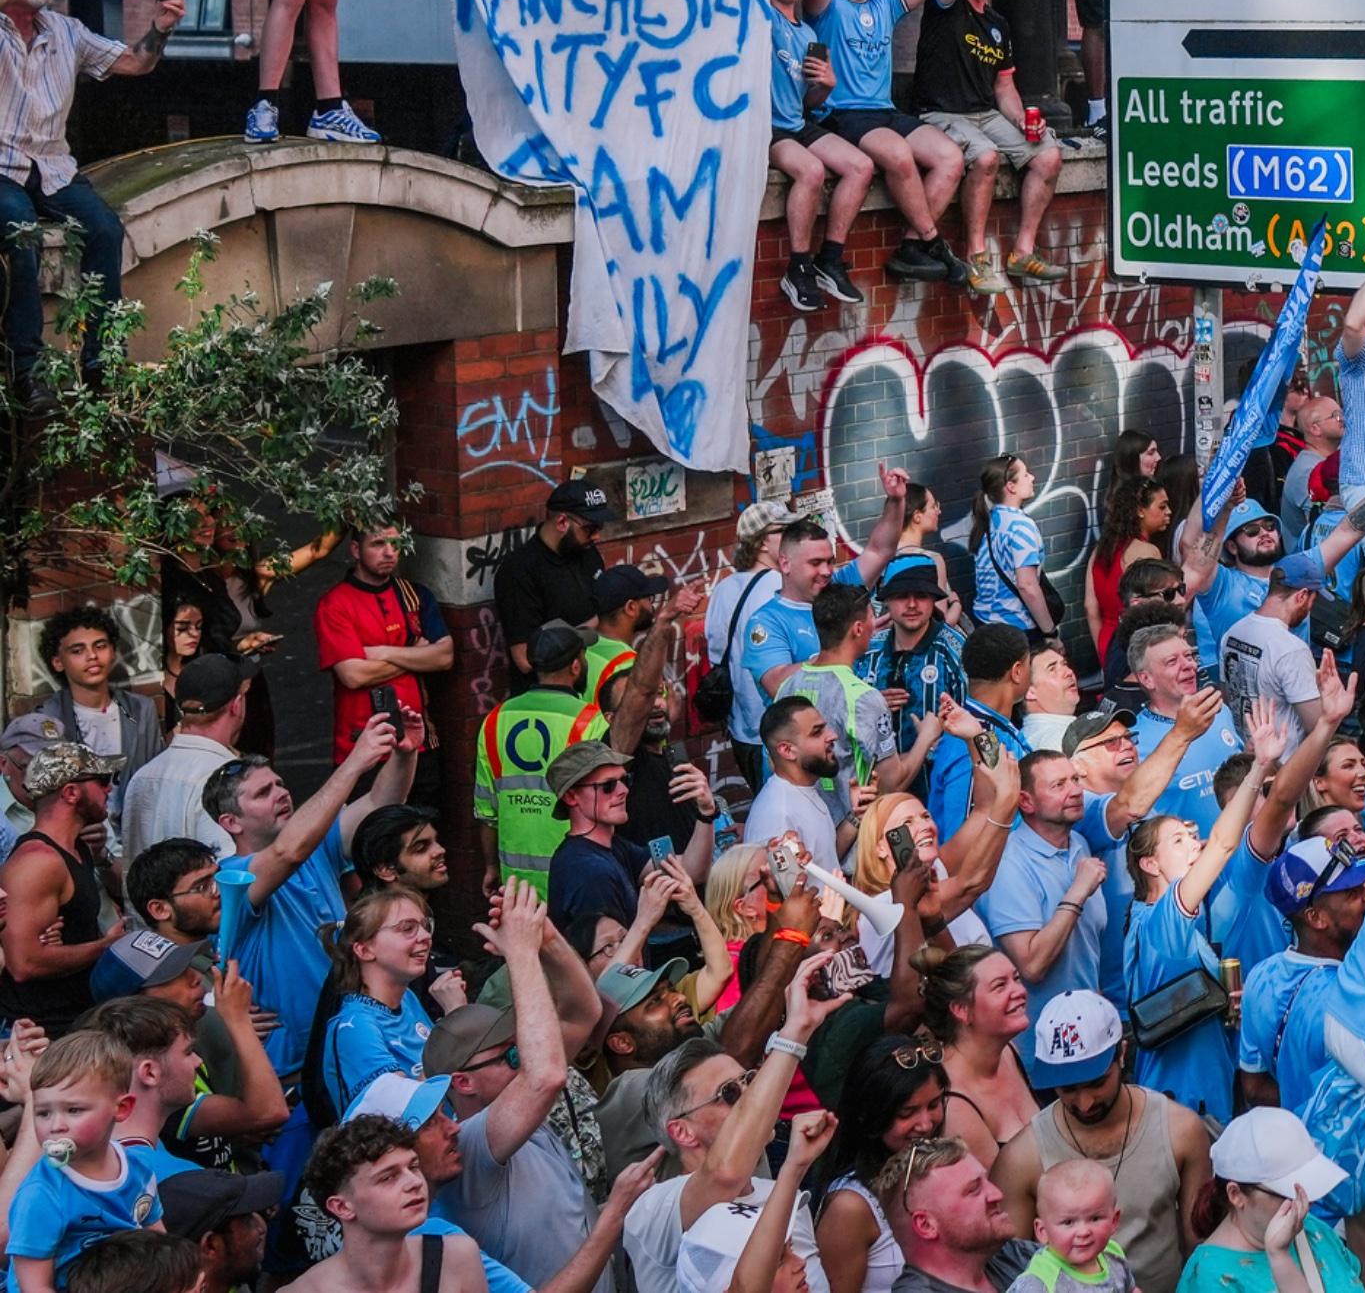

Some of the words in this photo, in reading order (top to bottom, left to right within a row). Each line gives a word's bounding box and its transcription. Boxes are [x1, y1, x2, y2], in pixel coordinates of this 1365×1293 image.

[1124, 88, 1169, 124] All
[1180, 89, 1285, 126] traffic
[1126, 151, 1219, 188] Leeds
[1232, 148, 1349, 197] (M62)
[1126, 210, 1253, 252] Oldham
